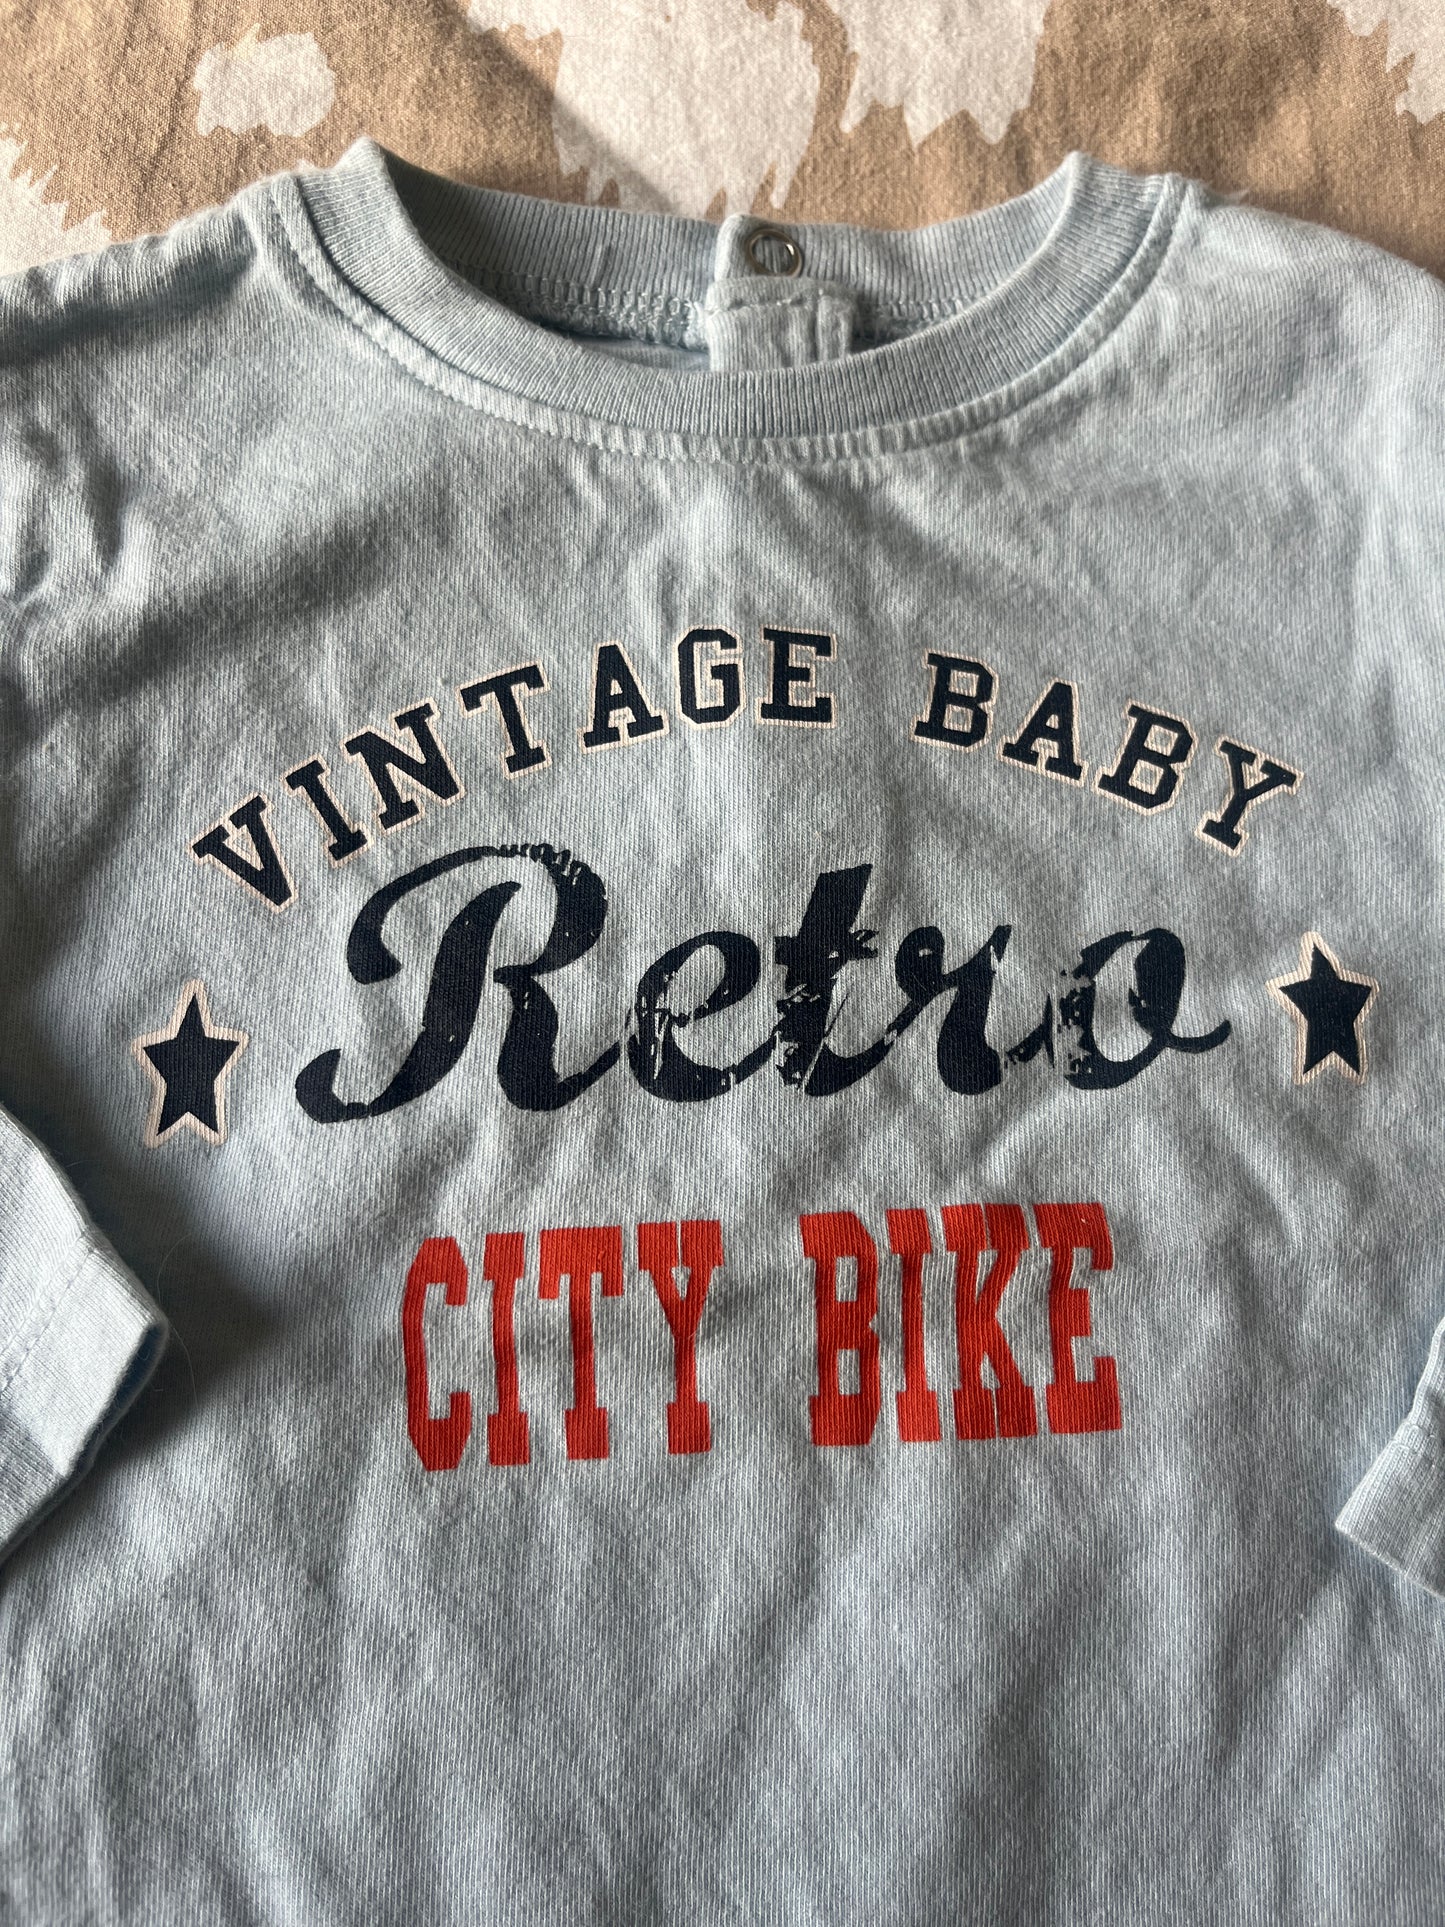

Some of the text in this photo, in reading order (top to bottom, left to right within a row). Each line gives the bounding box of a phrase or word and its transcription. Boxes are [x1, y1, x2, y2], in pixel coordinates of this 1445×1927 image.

[193, 625, 1299, 914] VINTAGE BABY
[296, 843, 1232, 1123] Retro
[403, 1201, 1124, 1471] CITY BIKE
